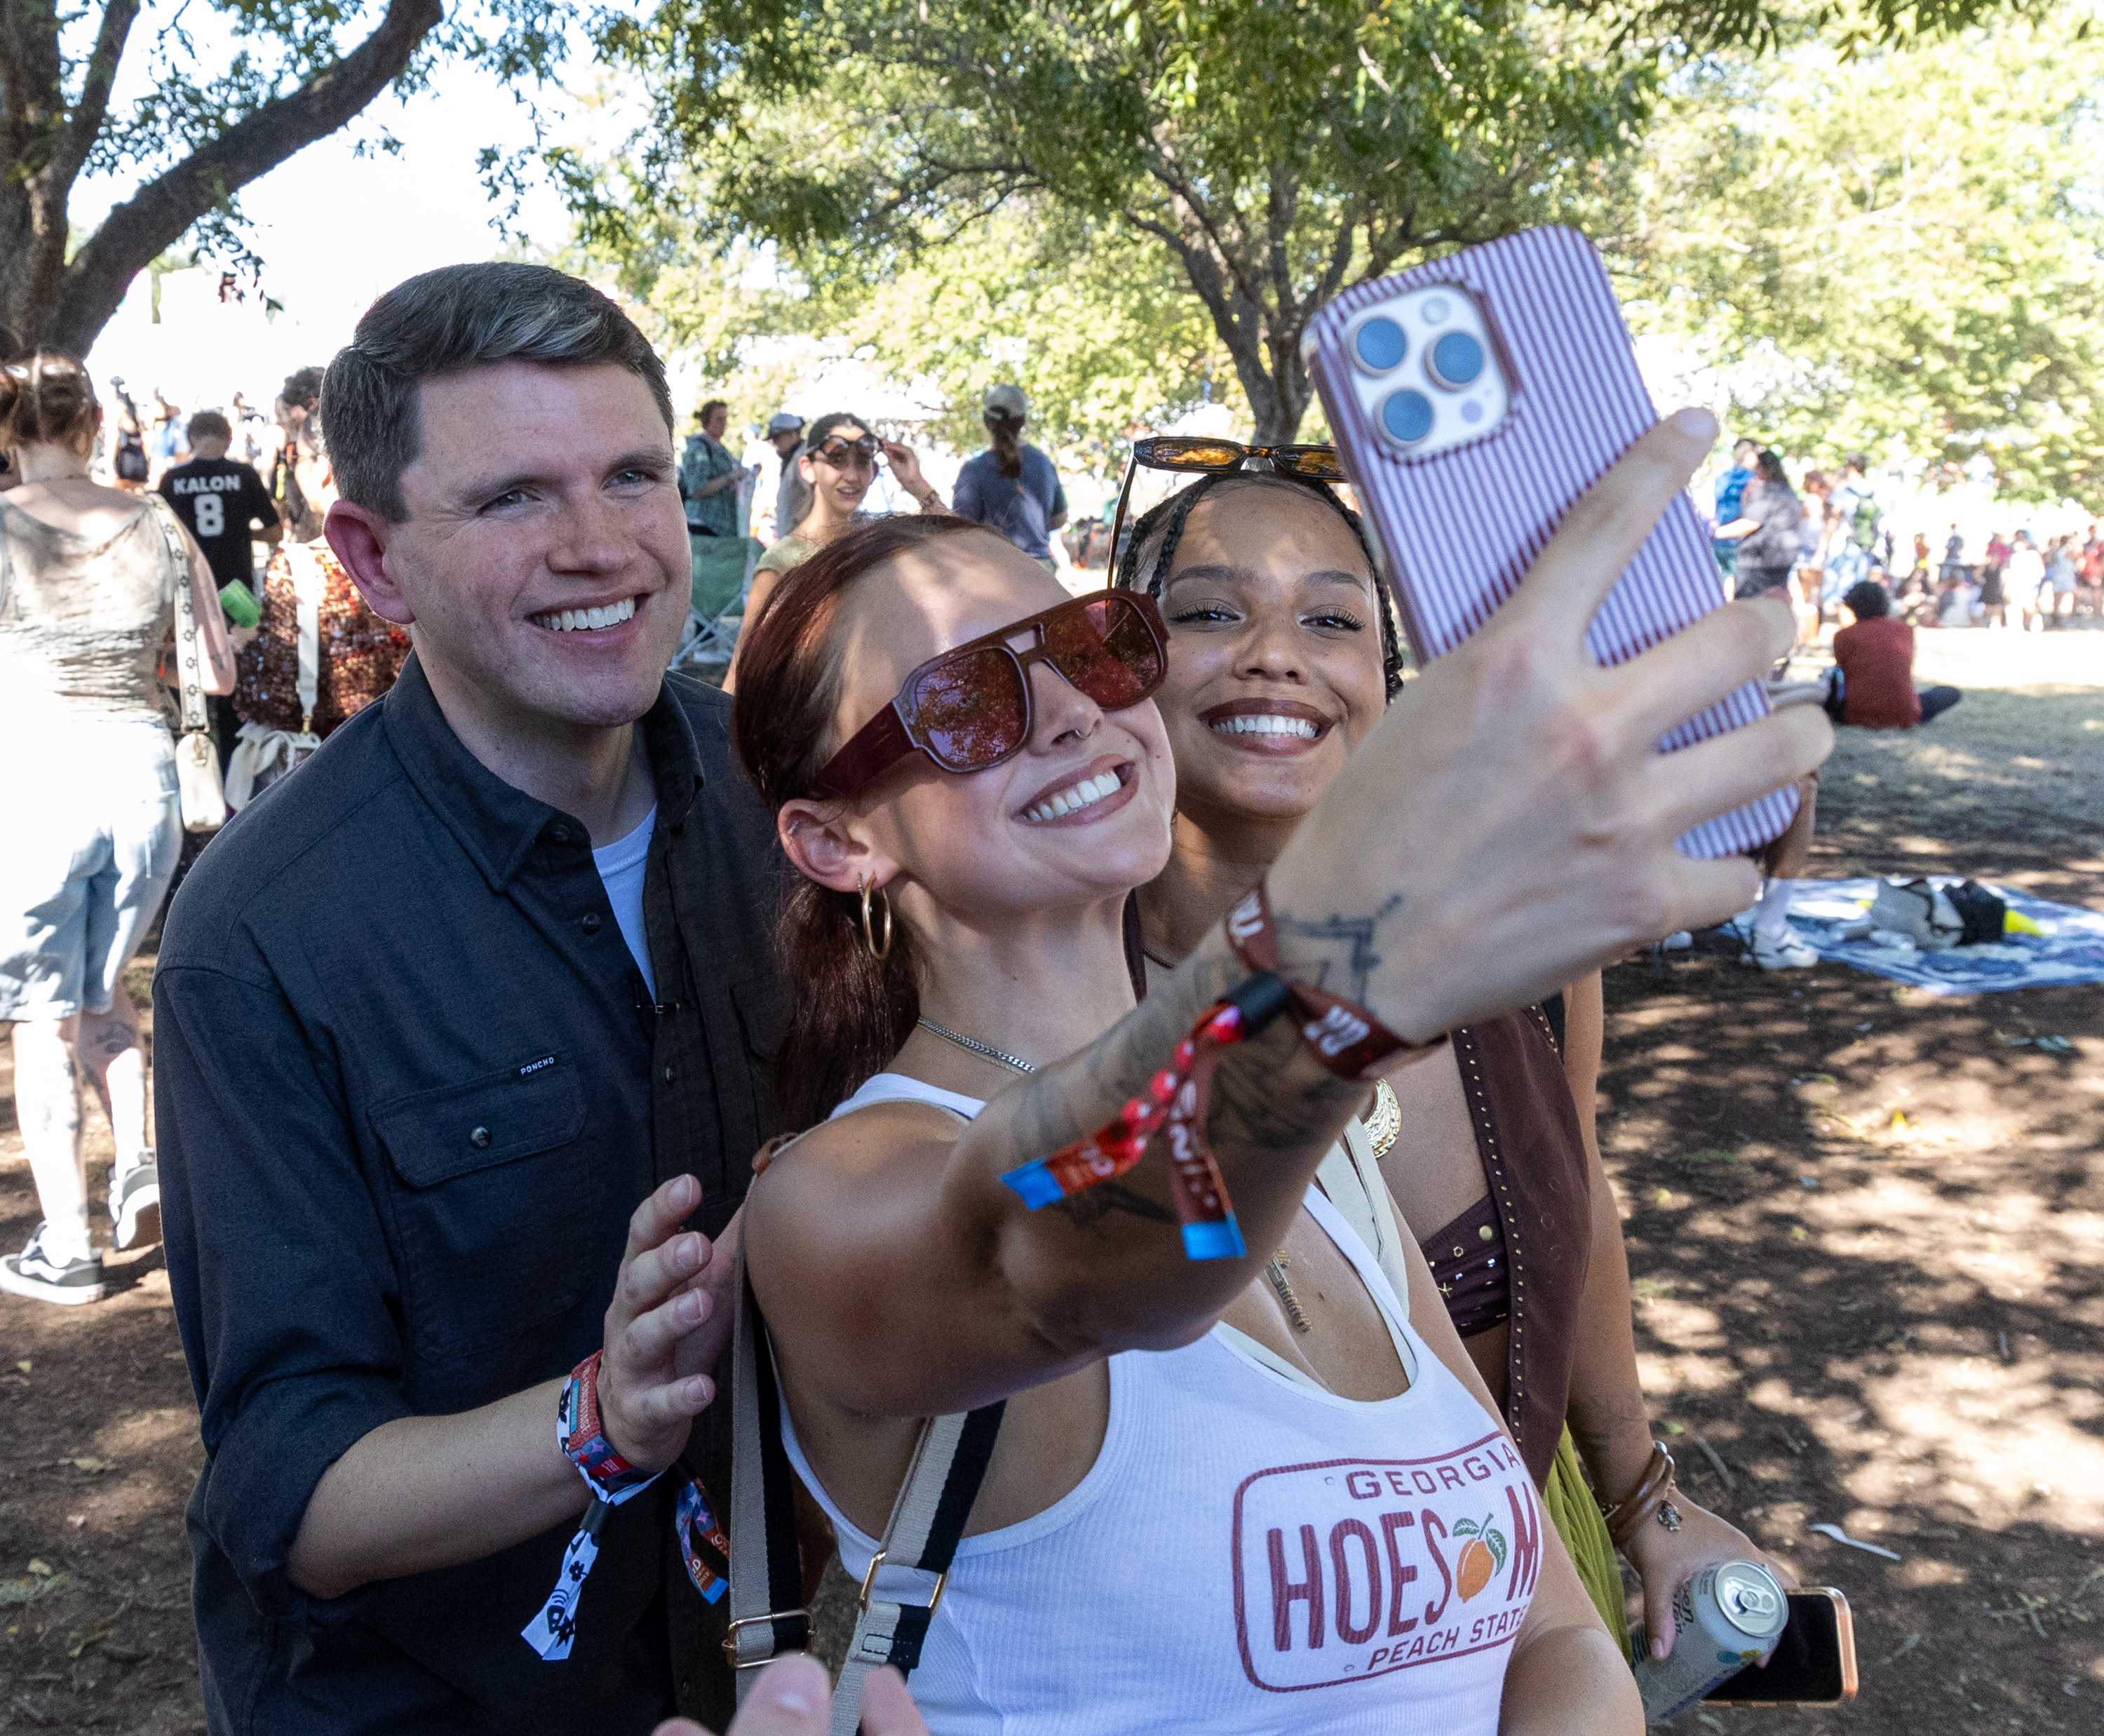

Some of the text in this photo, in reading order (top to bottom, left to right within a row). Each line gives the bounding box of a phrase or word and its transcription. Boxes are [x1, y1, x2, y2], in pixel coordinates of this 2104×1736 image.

[173, 474, 241, 495] KALON
[194, 493, 225, 537] 8
[520, 1056, 554, 1075] PONCHO
[1345, 1443, 1520, 1500] GEORGIA
[1267, 1481, 1539, 1652] HOES M
[1367, 1627, 1460, 1671] PEACH
